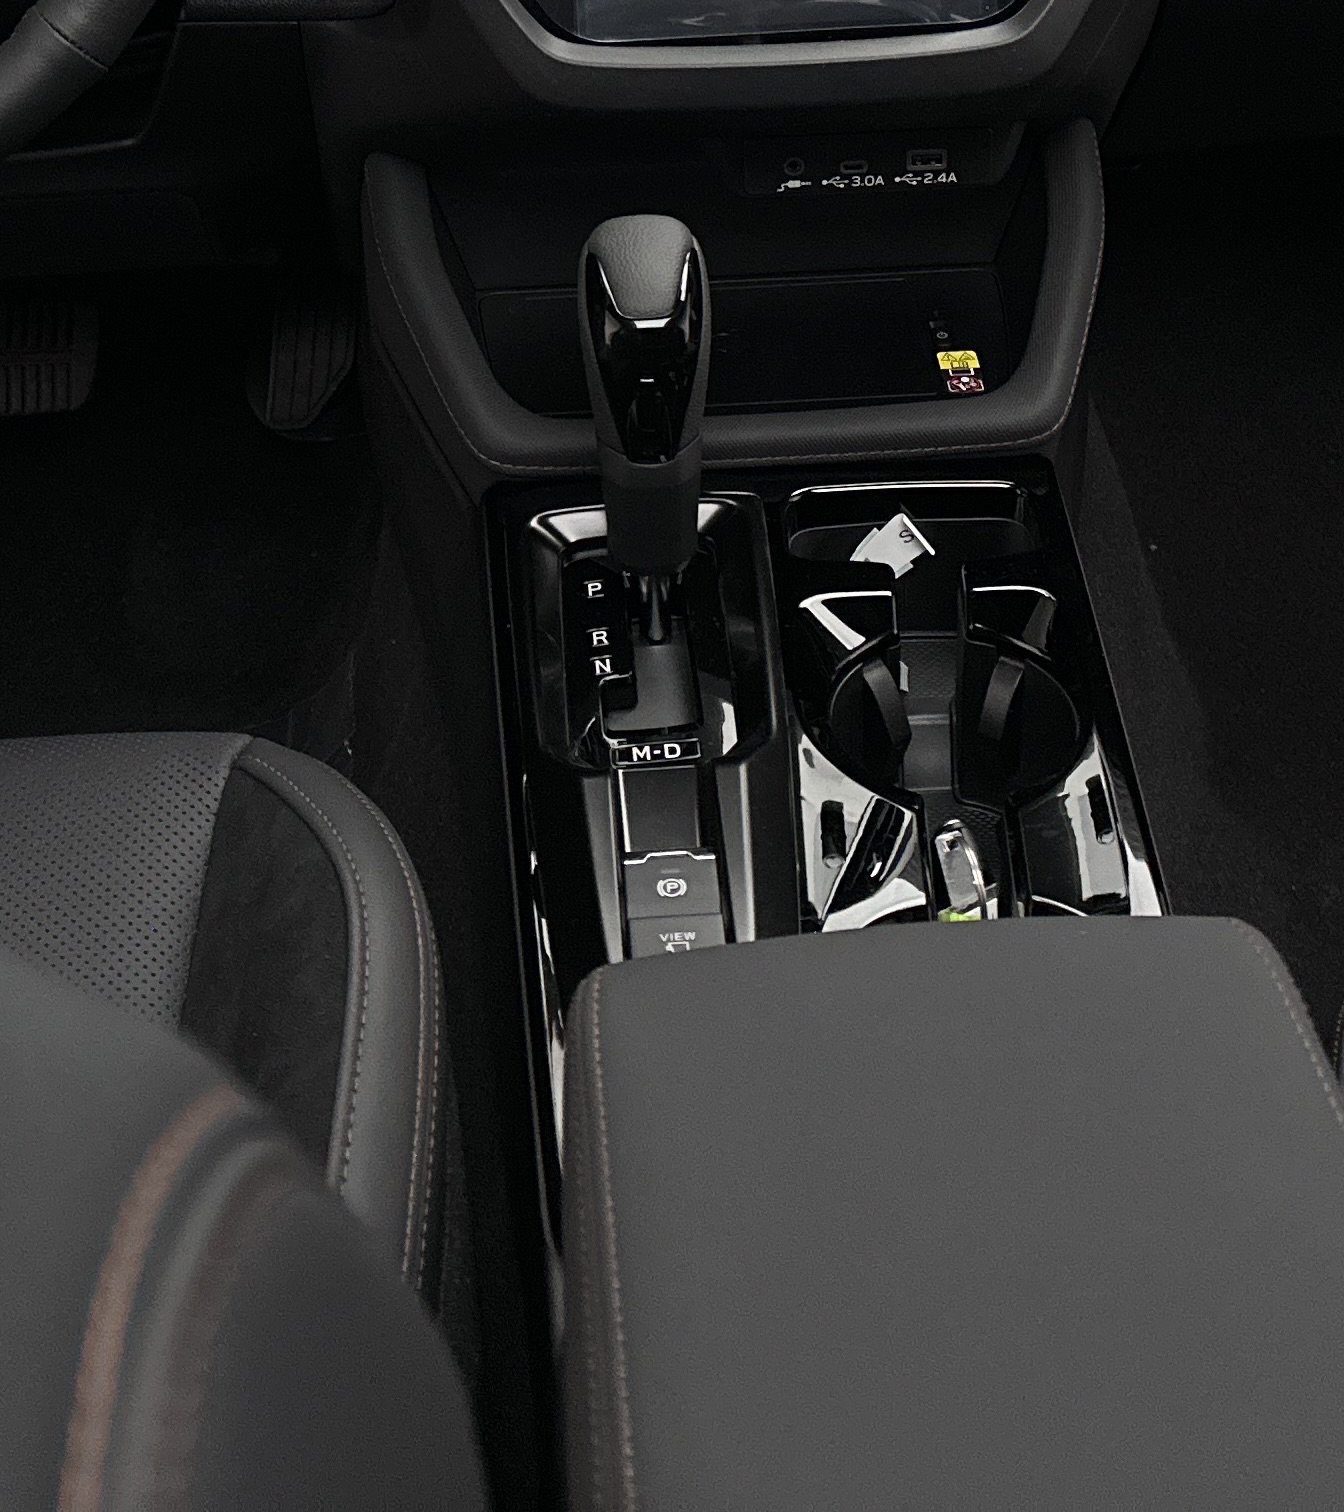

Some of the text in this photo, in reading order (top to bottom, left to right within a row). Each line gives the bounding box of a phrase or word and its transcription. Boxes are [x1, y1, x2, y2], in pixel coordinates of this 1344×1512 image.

[851, 172, 958, 187] 3.0A 2.4A
[587, 581, 603, 597] P
[592, 630, 609, 646] R
[595, 658, 612, 674] N
[631, 743, 682, 762] M-D
[659, 931, 696, 942] VIEW
